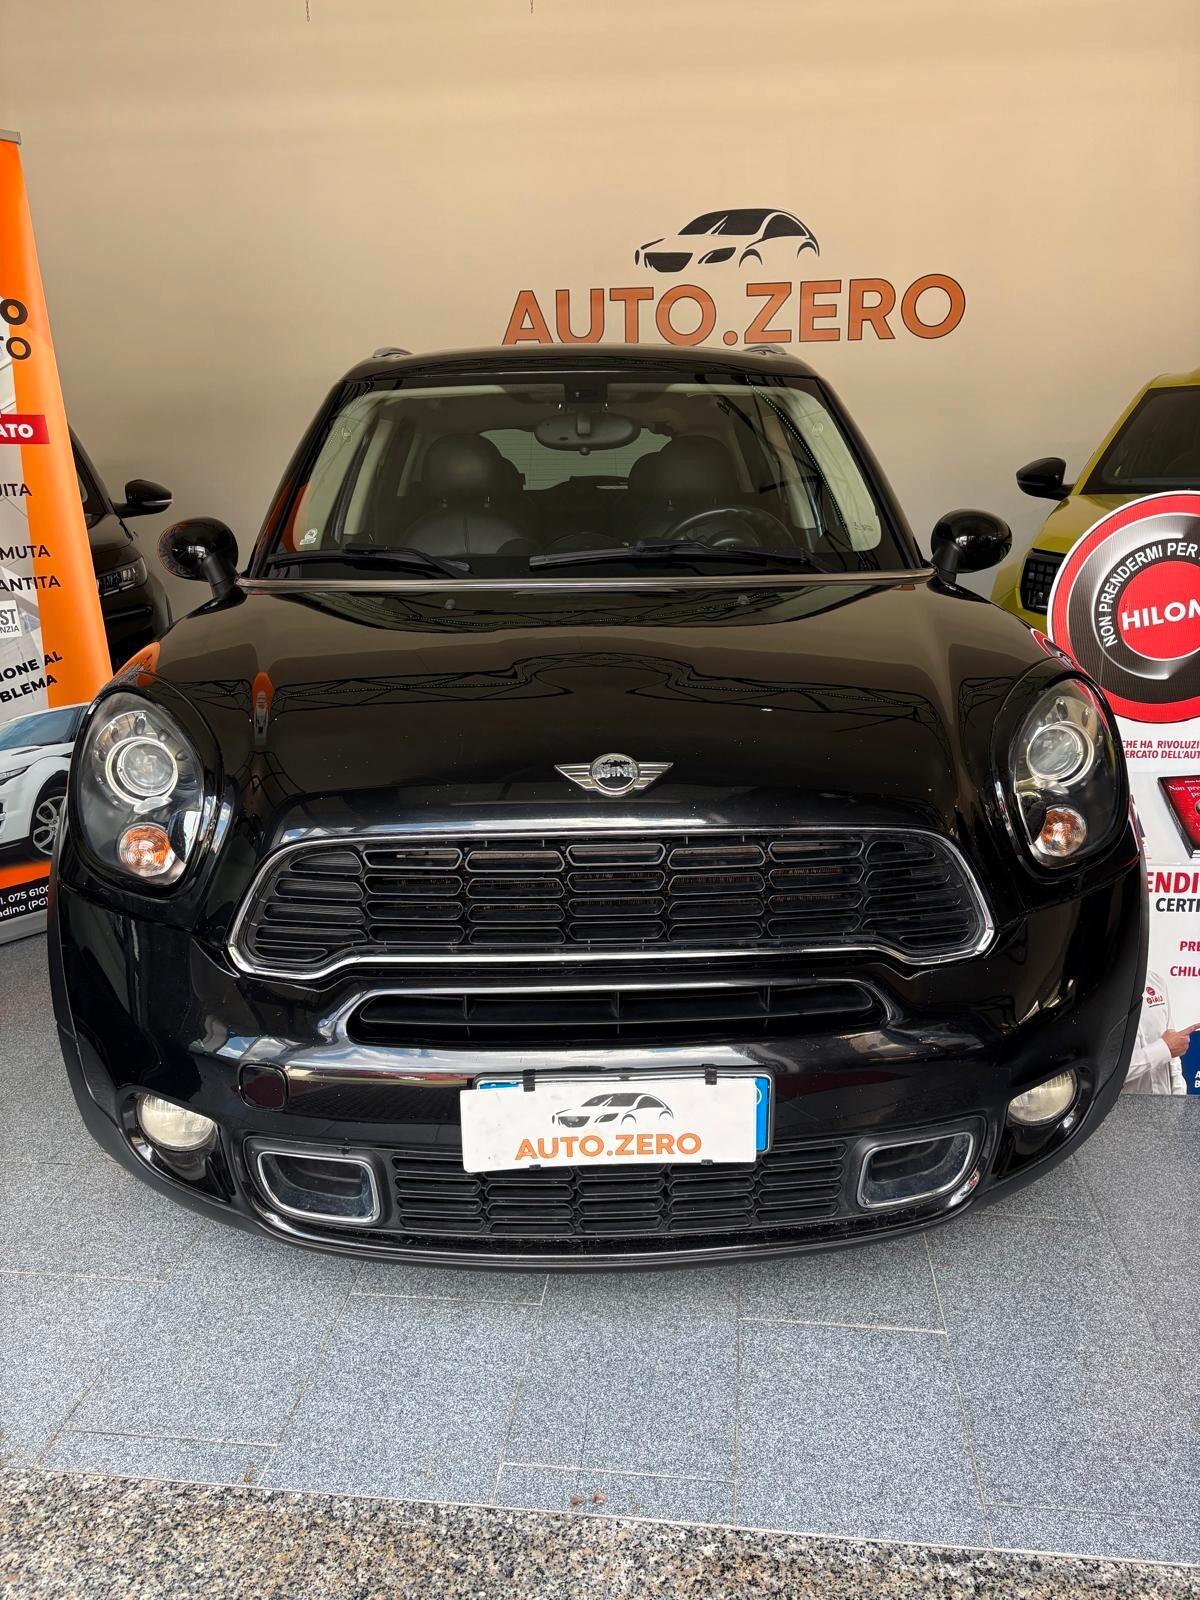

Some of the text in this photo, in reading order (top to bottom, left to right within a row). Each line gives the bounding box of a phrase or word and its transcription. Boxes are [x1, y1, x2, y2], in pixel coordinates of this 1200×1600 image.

[501, 273, 966, 346] AUTO.ZERO
[0, 483, 32, 496] ITA
[1098, 542, 1199, 648] NON PRENDERMI PER
[44, 651, 63, 666] AL
[1140, 740, 1153, 749] HA
[8, 891, 27, 903] 075
[514, 1132, 703, 1161] AUTO.ZERO
